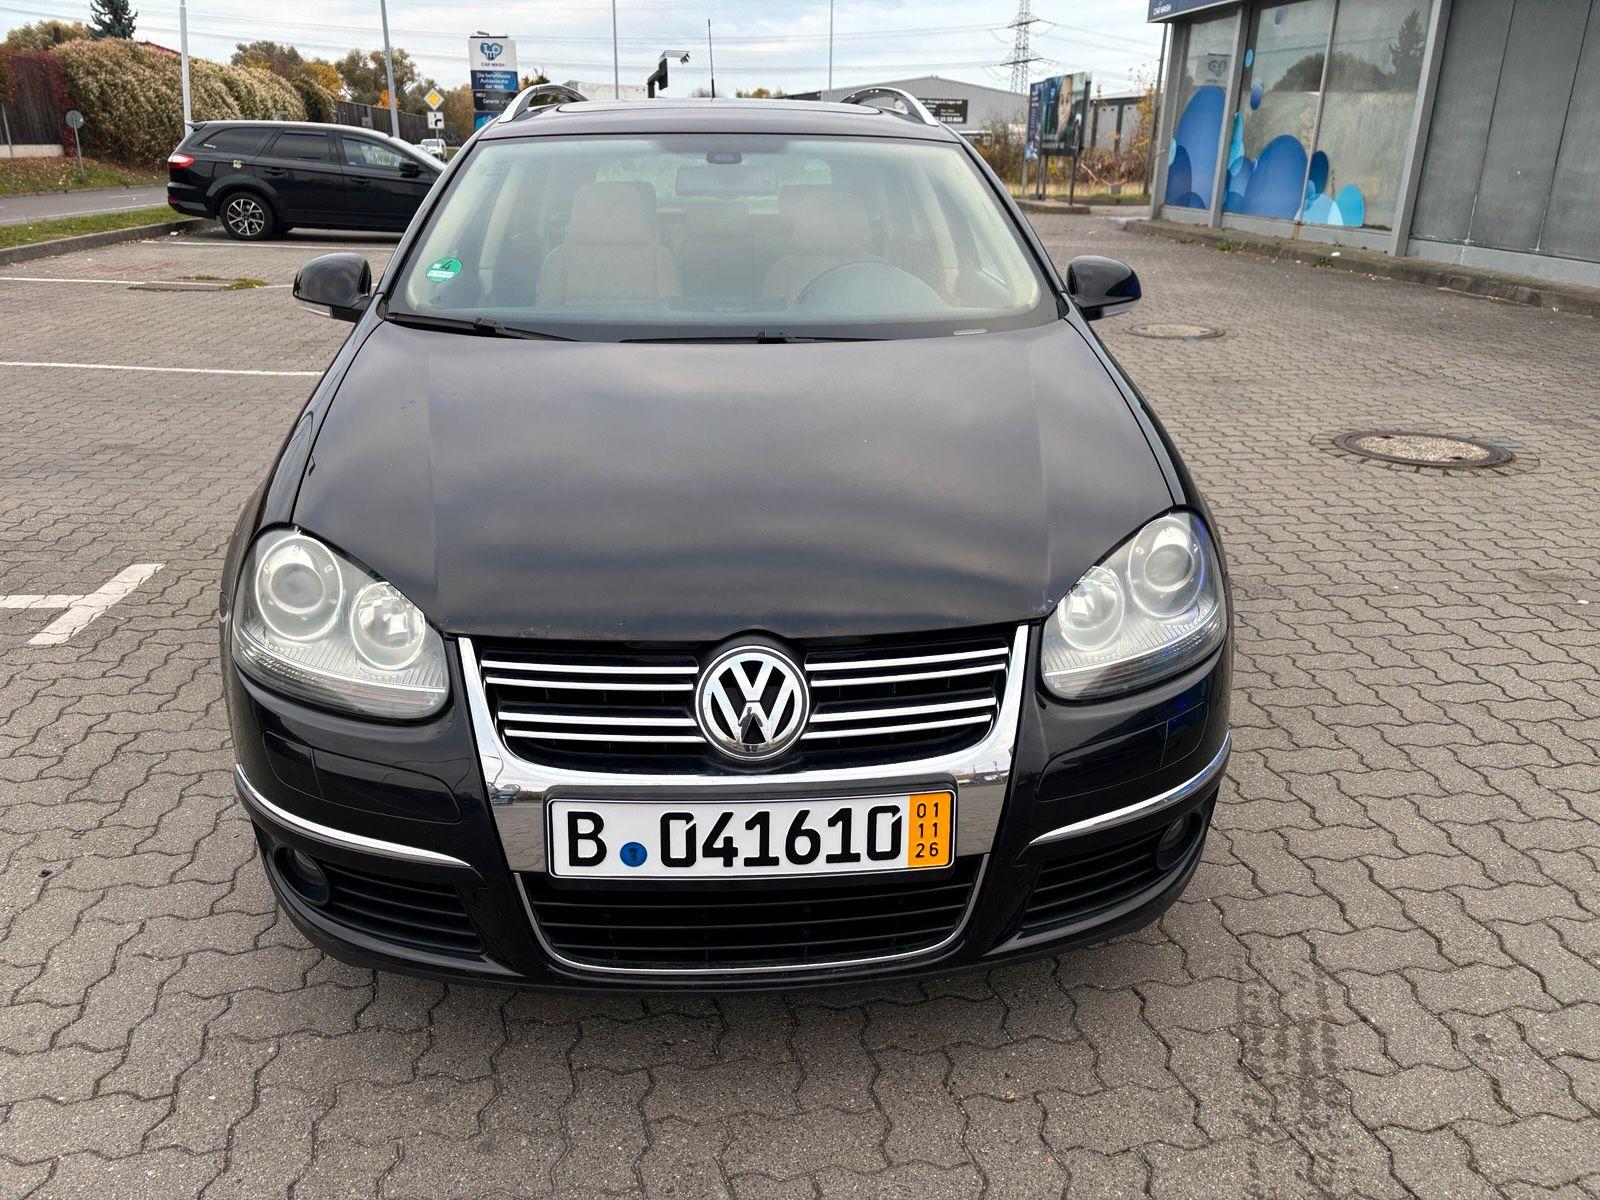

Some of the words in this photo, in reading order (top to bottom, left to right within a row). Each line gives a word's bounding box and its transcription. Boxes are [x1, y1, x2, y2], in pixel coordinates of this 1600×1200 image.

[916, 802, 939, 818] 01
[567, 811, 607, 867] B
[660, 804, 903, 868] 041610
[918, 822, 938, 838] 11
[915, 841, 939, 859] 26
